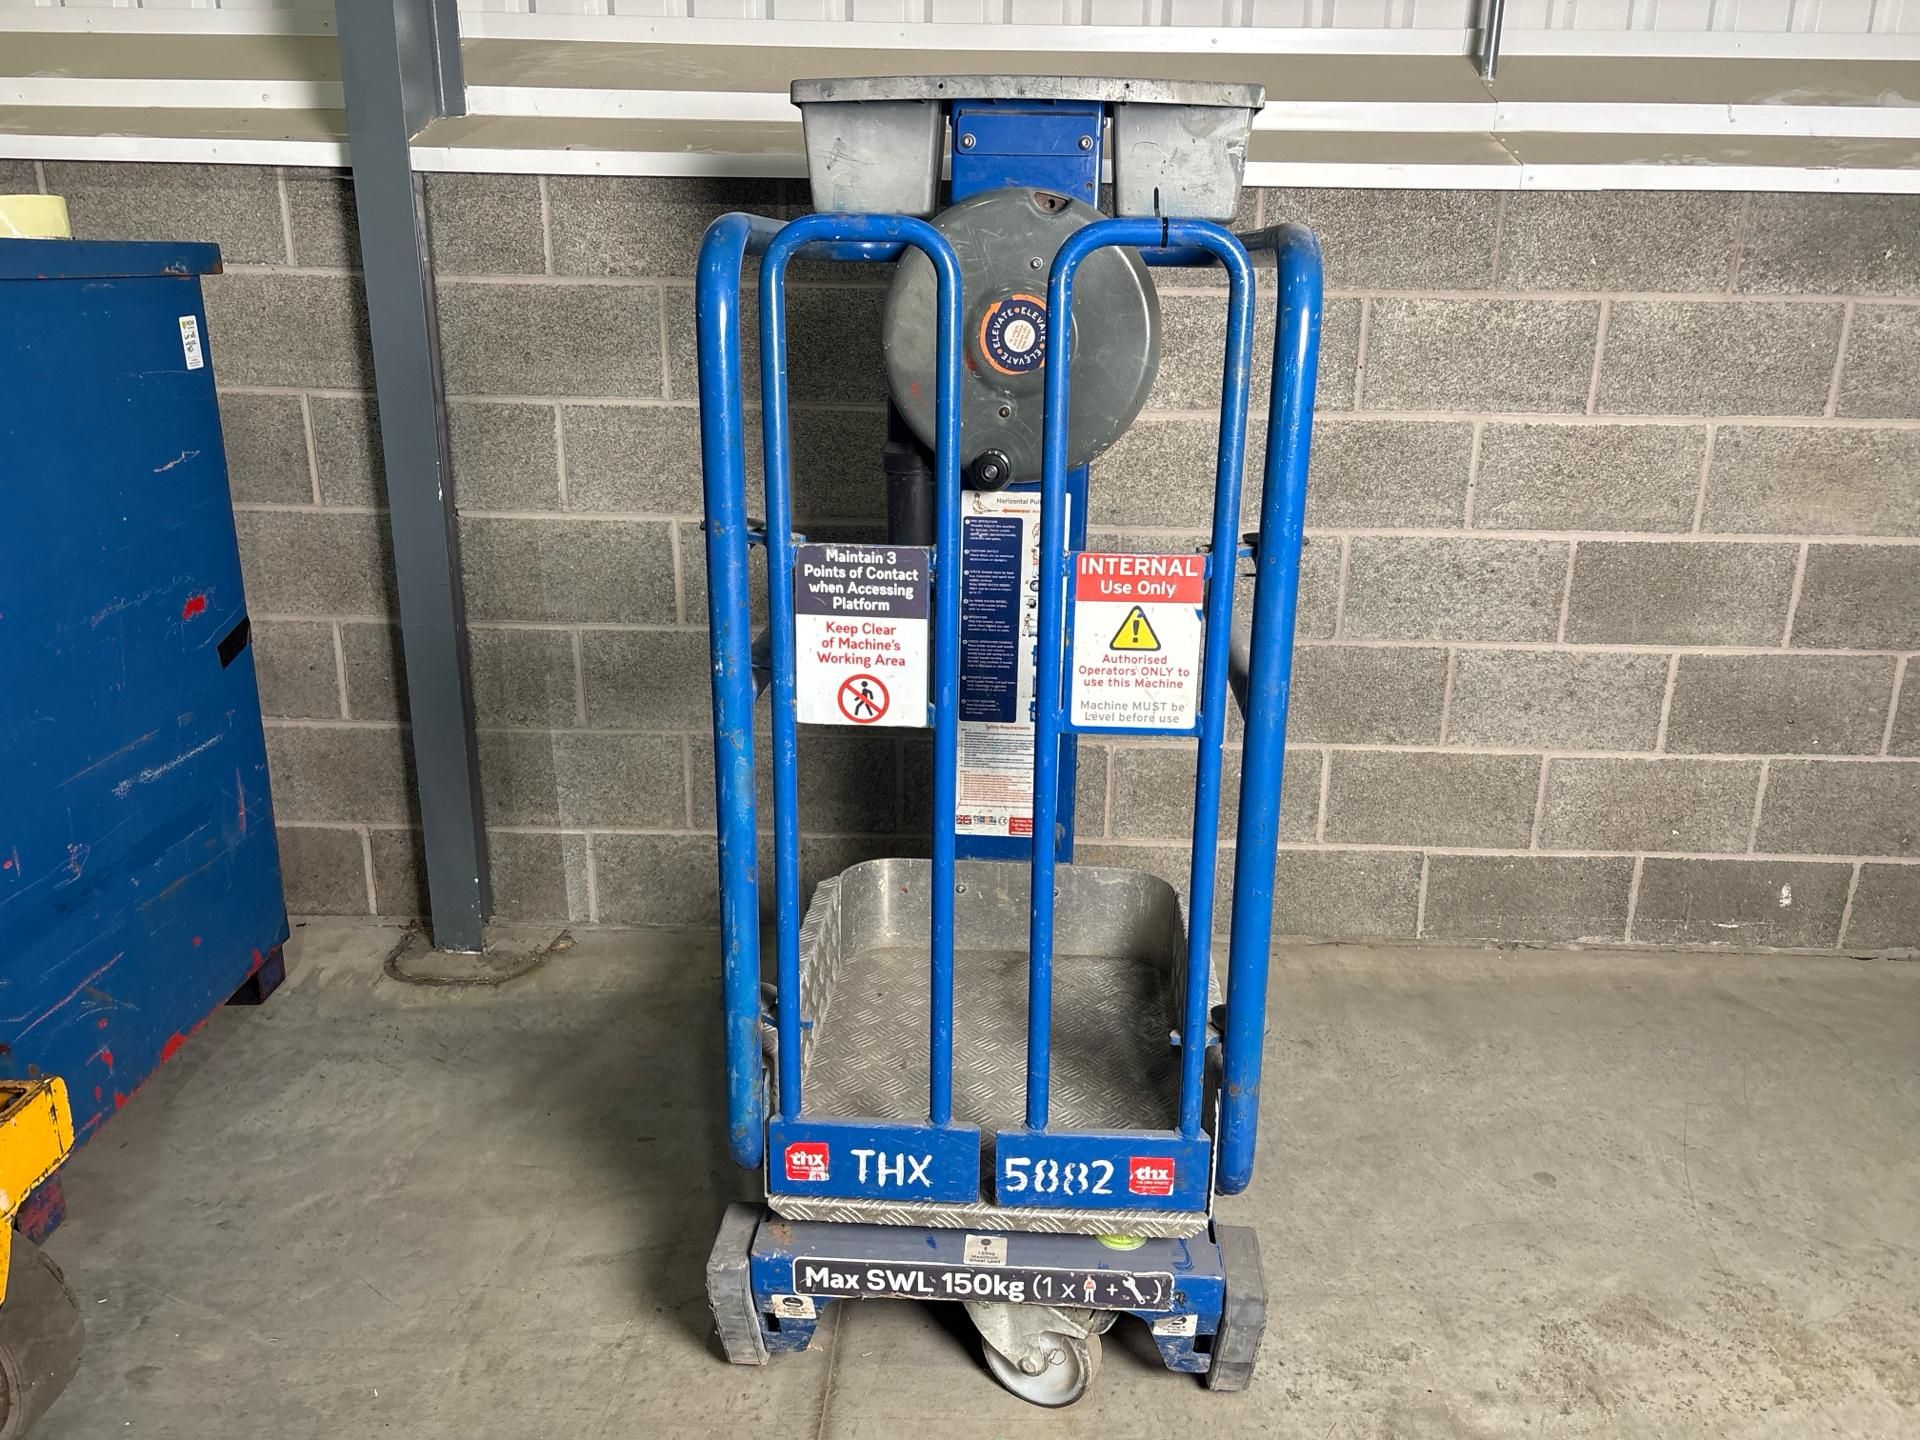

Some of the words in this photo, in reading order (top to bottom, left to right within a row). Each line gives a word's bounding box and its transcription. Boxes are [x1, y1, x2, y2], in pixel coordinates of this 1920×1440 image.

[992, 308, 1014, 348] ELEVATE
[1001, 349, 1042, 366] ELEVATE
[826, 549, 884, 564] Maintain
[886, 551, 897, 565] 3
[804, 564, 846, 578] Points
[849, 566, 863, 579] of
[866, 567, 919, 581] Contact
[1081, 557, 1199, 577] INTERNAL
[809, 580, 844, 593] when
[847, 582, 914, 600] Accessing
[1100, 580, 1132, 595] Use
[1137, 580, 1177, 599] Only
[832, 596, 890, 611] Platform
[826, 621, 858, 637] Keep
[862, 622, 896, 635] Clear
[822, 637, 835, 649] of
[838, 637, 901, 651] Machine's
[817, 651, 871, 669] Working
[874, 654, 906, 667] Area
[1102, 654, 1168, 665] Authorised
[1078, 665, 1137, 678] Operators
[1141, 667, 1174, 677] ONLY
[1178, 668, 1190, 677] to
[1083, 678, 1104, 687] use
[1107, 678, 1131, 688] this
[1134, 679, 1184, 689] Machine
[1080, 700, 1128, 711] Machine
[1132, 702, 1167, 712] MUST
[1171, 702, 1185, 712] be
[1084, 711, 1115, 721] Level
[1119, 712, 1156, 723] before
[1159, 714, 1180, 723] use
[790, 1150, 824, 1166] thx
[850, 1149, 934, 1188] THX
[1005, 1157, 1115, 1196] 5882
[1135, 1165, 1170, 1180] thx
[805, 1266, 860, 1290] Max
[866, 1269, 934, 1293] SWL
[941, 1272, 1025, 1302] 150kg
[1032, 1274, 1052, 1300] (1
[1061, 1283, 1076, 1299] x
